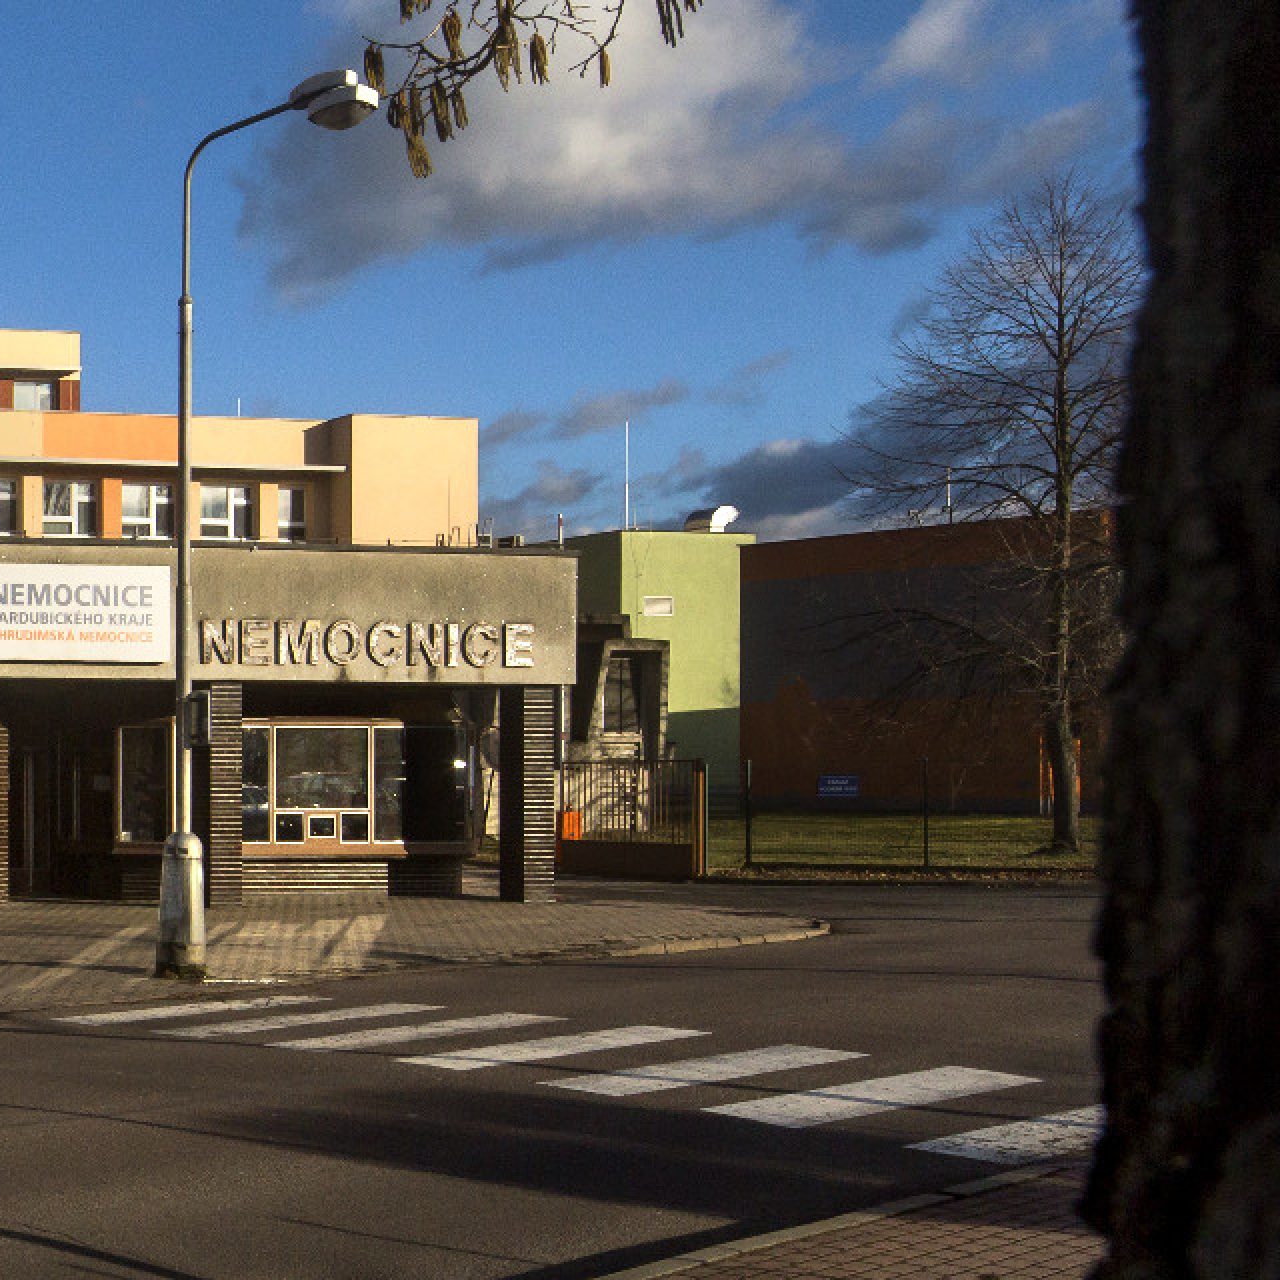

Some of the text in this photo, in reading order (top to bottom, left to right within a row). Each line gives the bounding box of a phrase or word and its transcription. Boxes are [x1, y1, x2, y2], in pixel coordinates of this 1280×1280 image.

[109, 613, 153, 627] KRAJE
[79, 631, 153, 643] NEMOCNICE
[197, 619, 535, 668] NEMOCNICE
